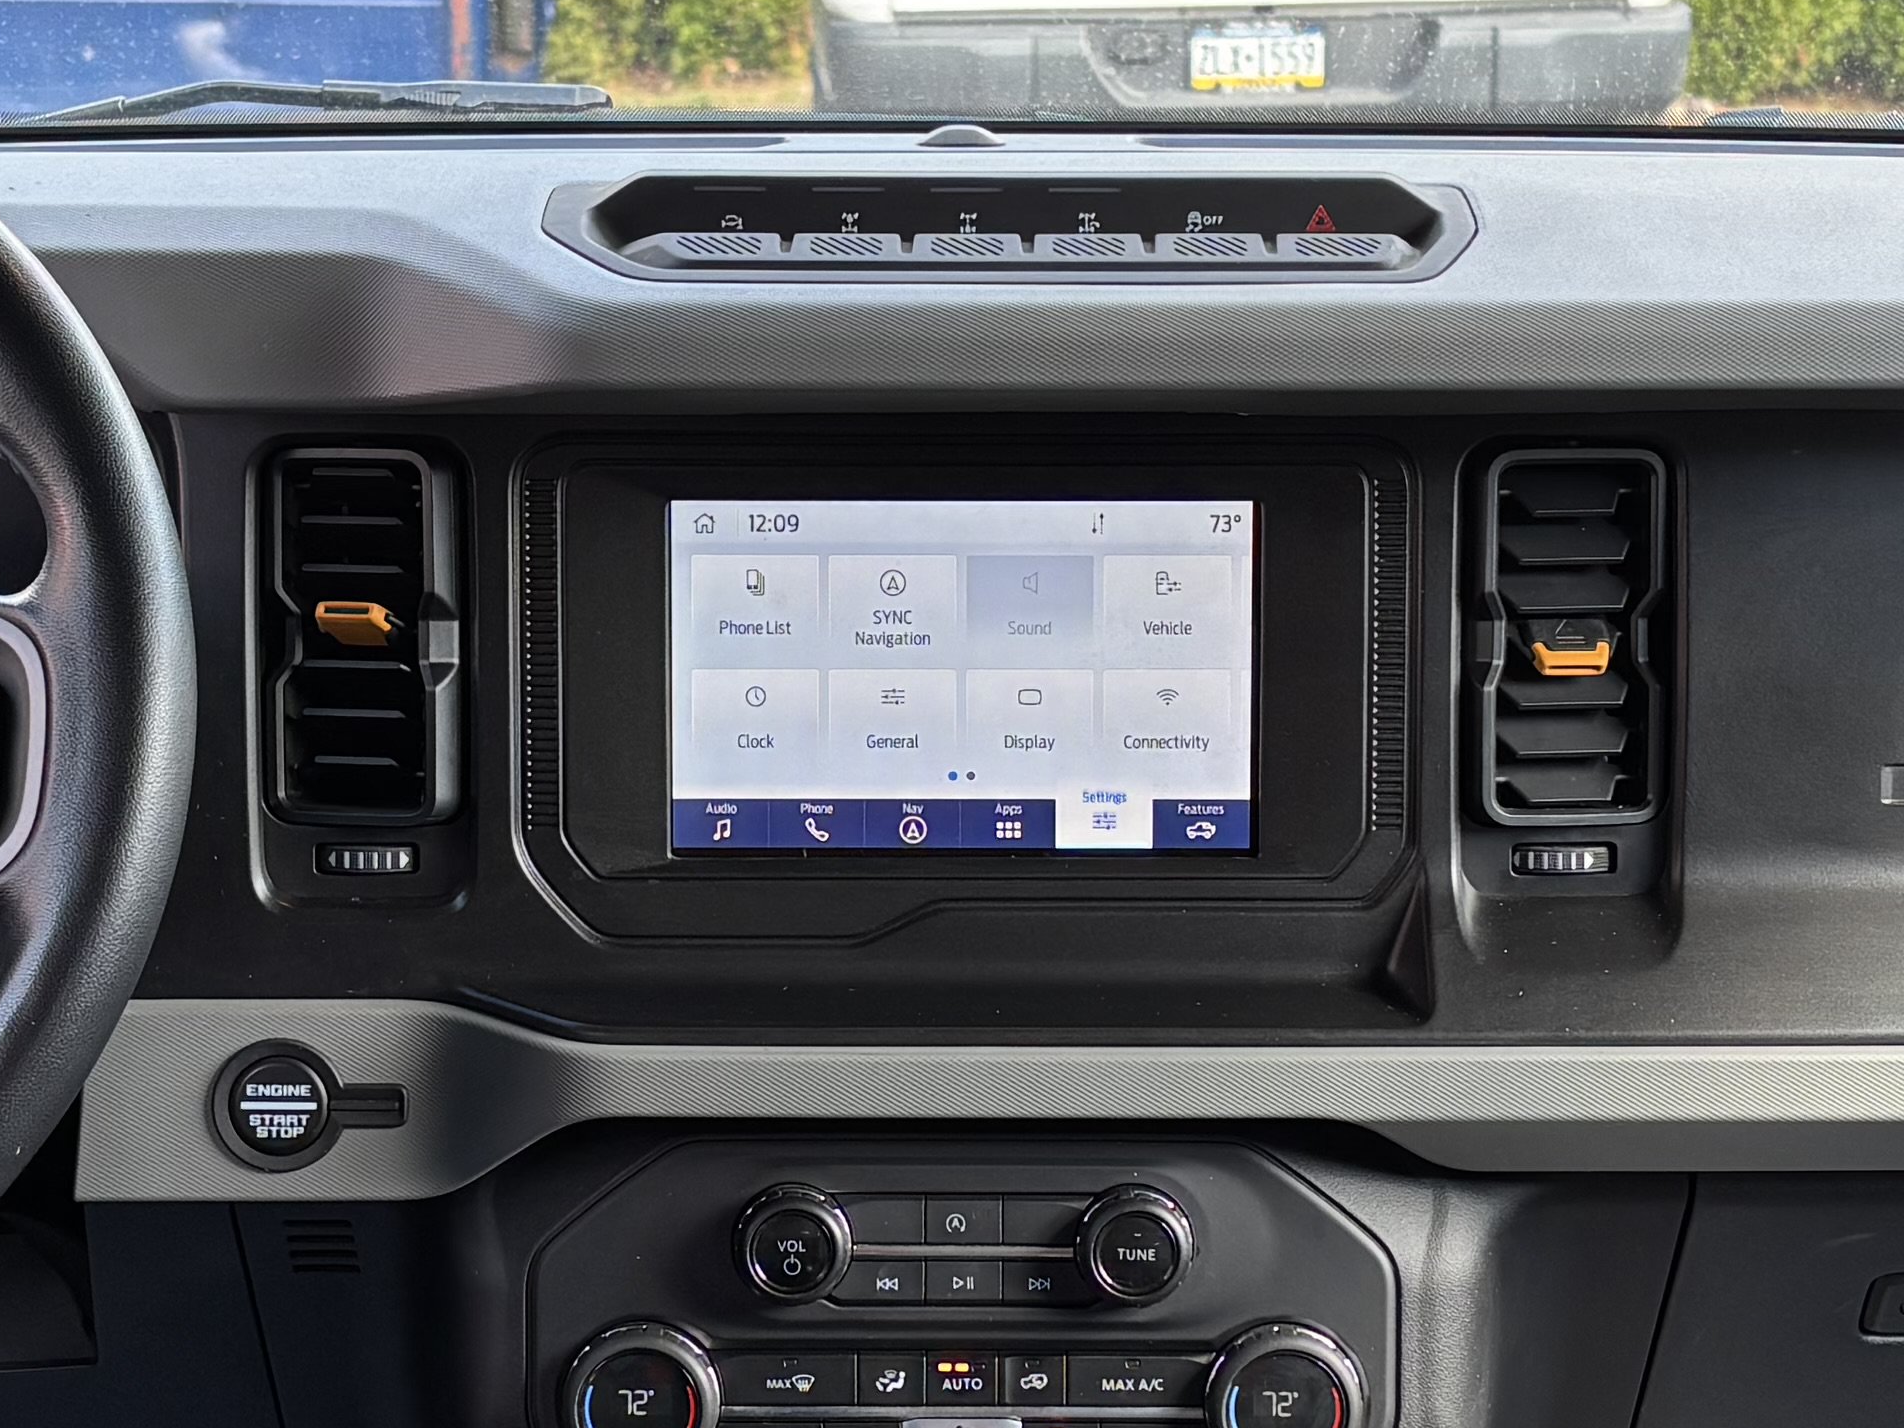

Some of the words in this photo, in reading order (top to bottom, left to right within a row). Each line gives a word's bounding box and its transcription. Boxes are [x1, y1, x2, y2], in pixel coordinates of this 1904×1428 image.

[748, 514, 800, 533] 12:09
[1209, 514, 1242, 533] 73°
[872, 610, 913, 625] SYNC
[719, 620, 763, 635] Phone
[766, 620, 792, 635] List
[1007, 621, 1052, 636] Sound
[1143, 621, 1193, 636] Vehicle
[854, 631, 931, 648] Navigation
[737, 733, 775, 749] Clock
[866, 733, 919, 749] General
[1003, 734, 1056, 752] Display
[1123, 734, 1210, 752] Connectivity
[1081, 791, 1127, 805] Settings
[705, 802, 738, 815] Audio
[799, 802, 834, 815] Phone
[902, 802, 924, 815] Nav
[995, 803, 1023, 817] Apps
[1177, 803, 1225, 816] Features
[245, 1084, 312, 1097] ENGINE
[249, 1114, 310, 1126] START
[256, 1126, 305, 1139] STOP
[777, 1240, 806, 1253] VOL
[1117, 1248, 1156, 1262] TUNE
[766, 1379, 792, 1390] MAX
[942, 1378, 983, 1391] AUTO
[1101, 1378, 1135, 1392] MAX
[1138, 1378, 1164, 1393] A/C
